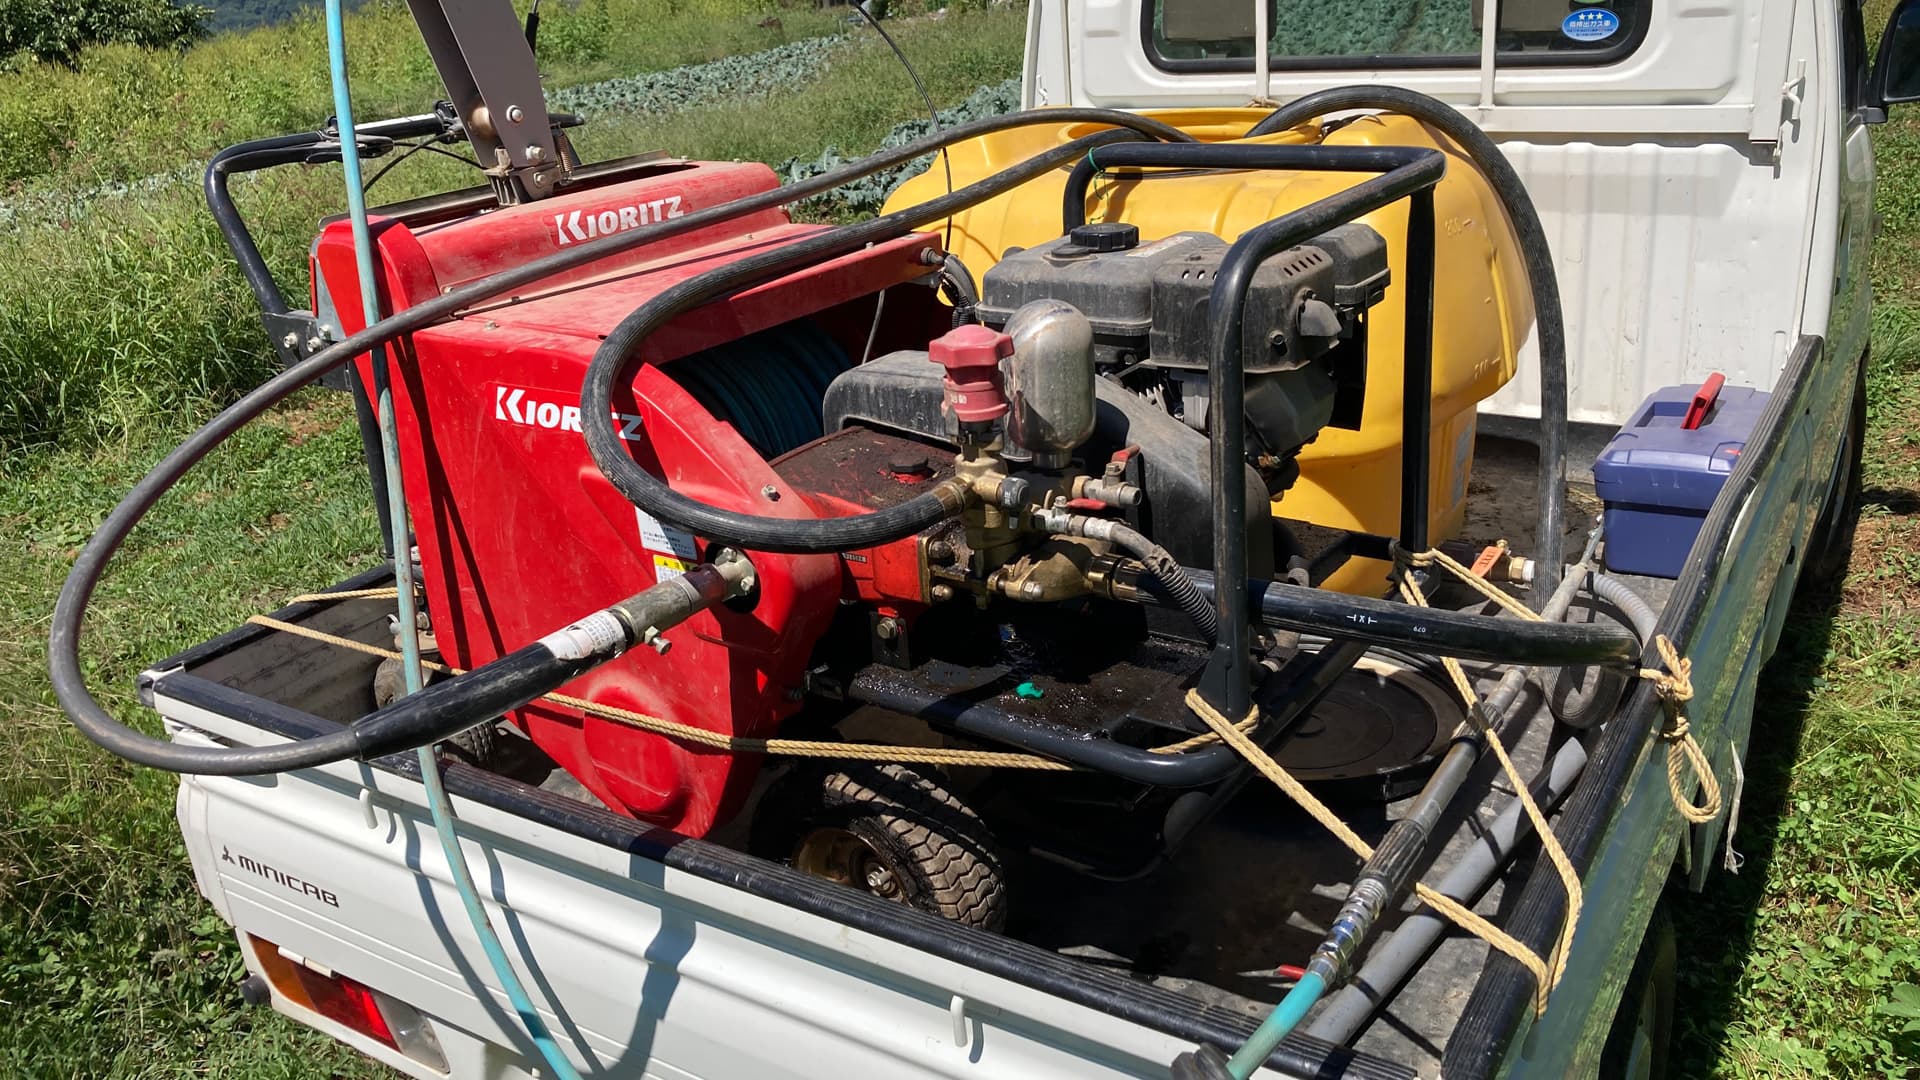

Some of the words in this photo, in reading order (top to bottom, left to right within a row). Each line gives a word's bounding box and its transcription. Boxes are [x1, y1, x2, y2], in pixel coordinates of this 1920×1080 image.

[554, 195, 684, 245] KIORITZ
[496, 386, 643, 441] KIORZ
[238, 854, 339, 908] MINICAB
